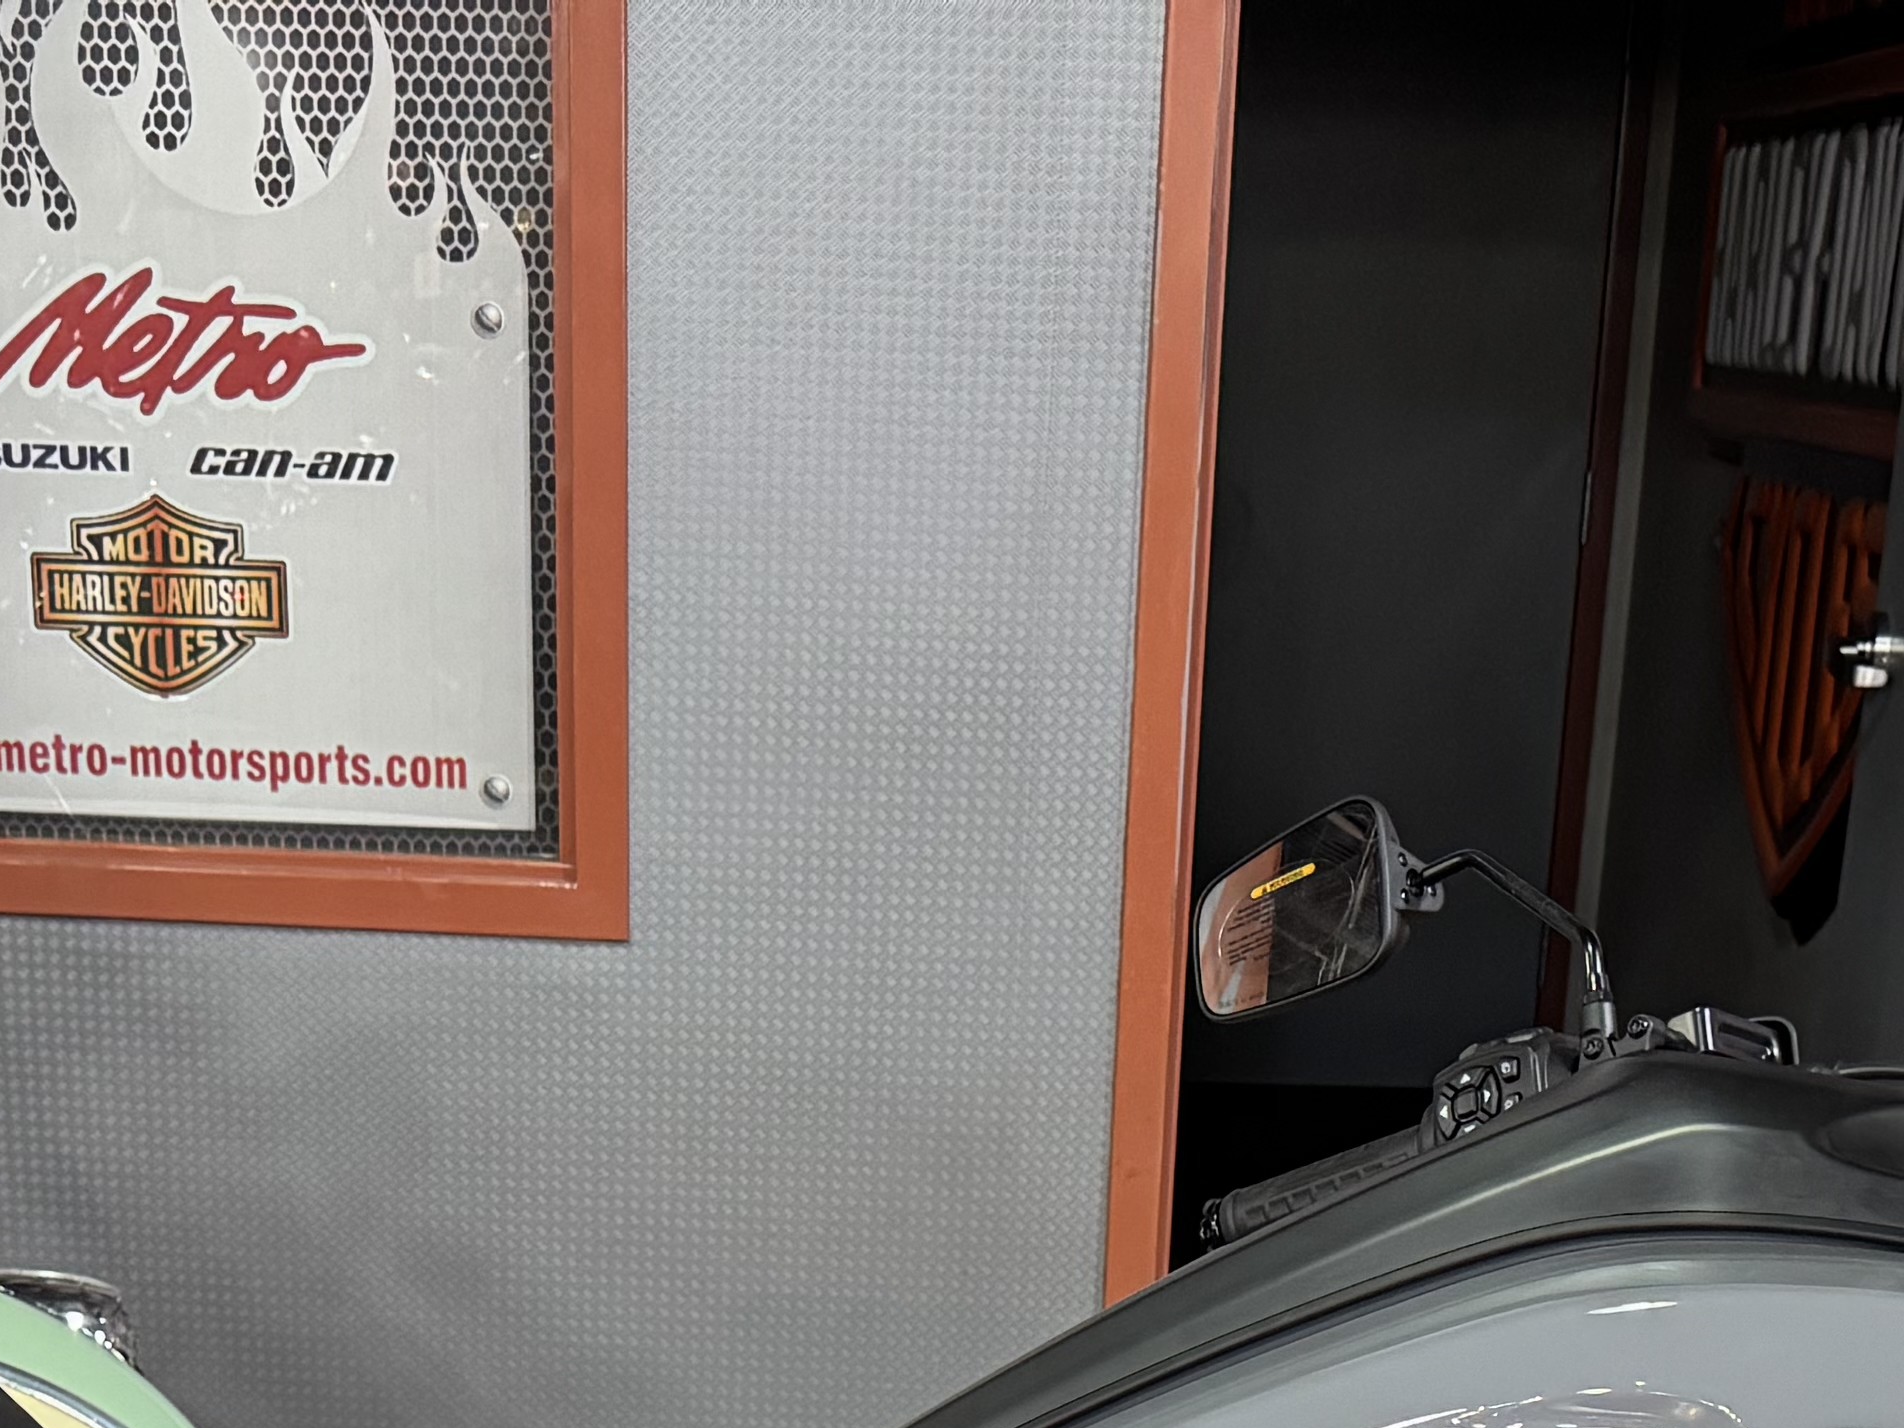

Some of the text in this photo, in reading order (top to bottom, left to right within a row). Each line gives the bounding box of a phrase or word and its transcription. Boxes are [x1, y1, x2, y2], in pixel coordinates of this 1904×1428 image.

[189, 446, 395, 482] can-am
[102, 525, 216, 565] MOTOR
[53, 572, 268, 619] HARLEY-DAVIDSON
[107, 627, 219, 675] CYCLES
